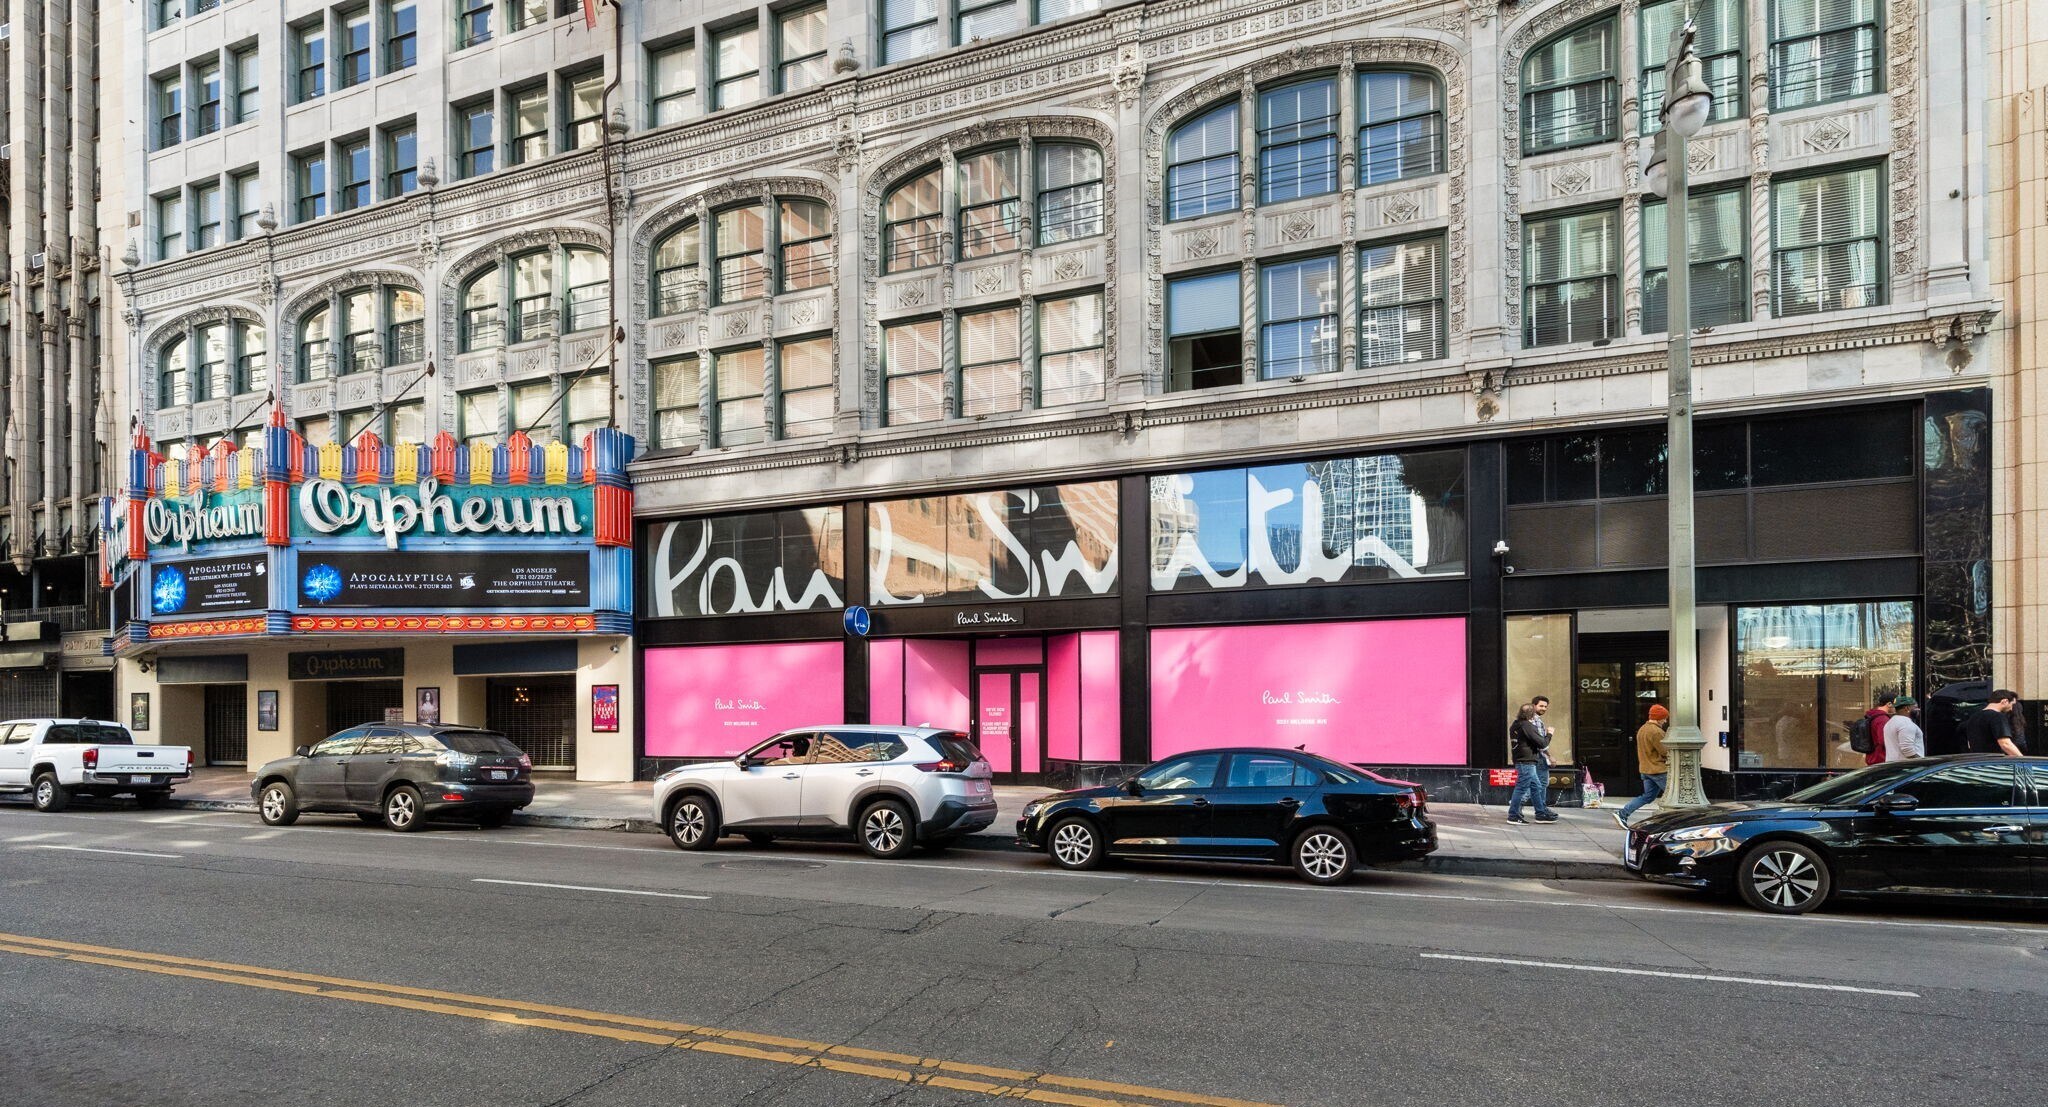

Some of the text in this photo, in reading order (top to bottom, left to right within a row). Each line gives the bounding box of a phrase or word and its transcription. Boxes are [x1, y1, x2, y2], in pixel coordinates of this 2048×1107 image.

[300, 476, 583, 550] Orpheum
[143, 487, 265, 554] Orpheum
[655, 471, 1430, 617] Paul Smith
[189, 563, 252, 574] APOCALYPTICA
[350, 572, 453, 582] APOCALYPTICA
[957, 611, 1018, 625] Paul Smith
[306, 655, 385, 676] Orpheum
[1581, 678, 1610, 689] 846
[715, 698, 767, 710] Paul Smith
[1263, 690, 1341, 704] Paul Smith
